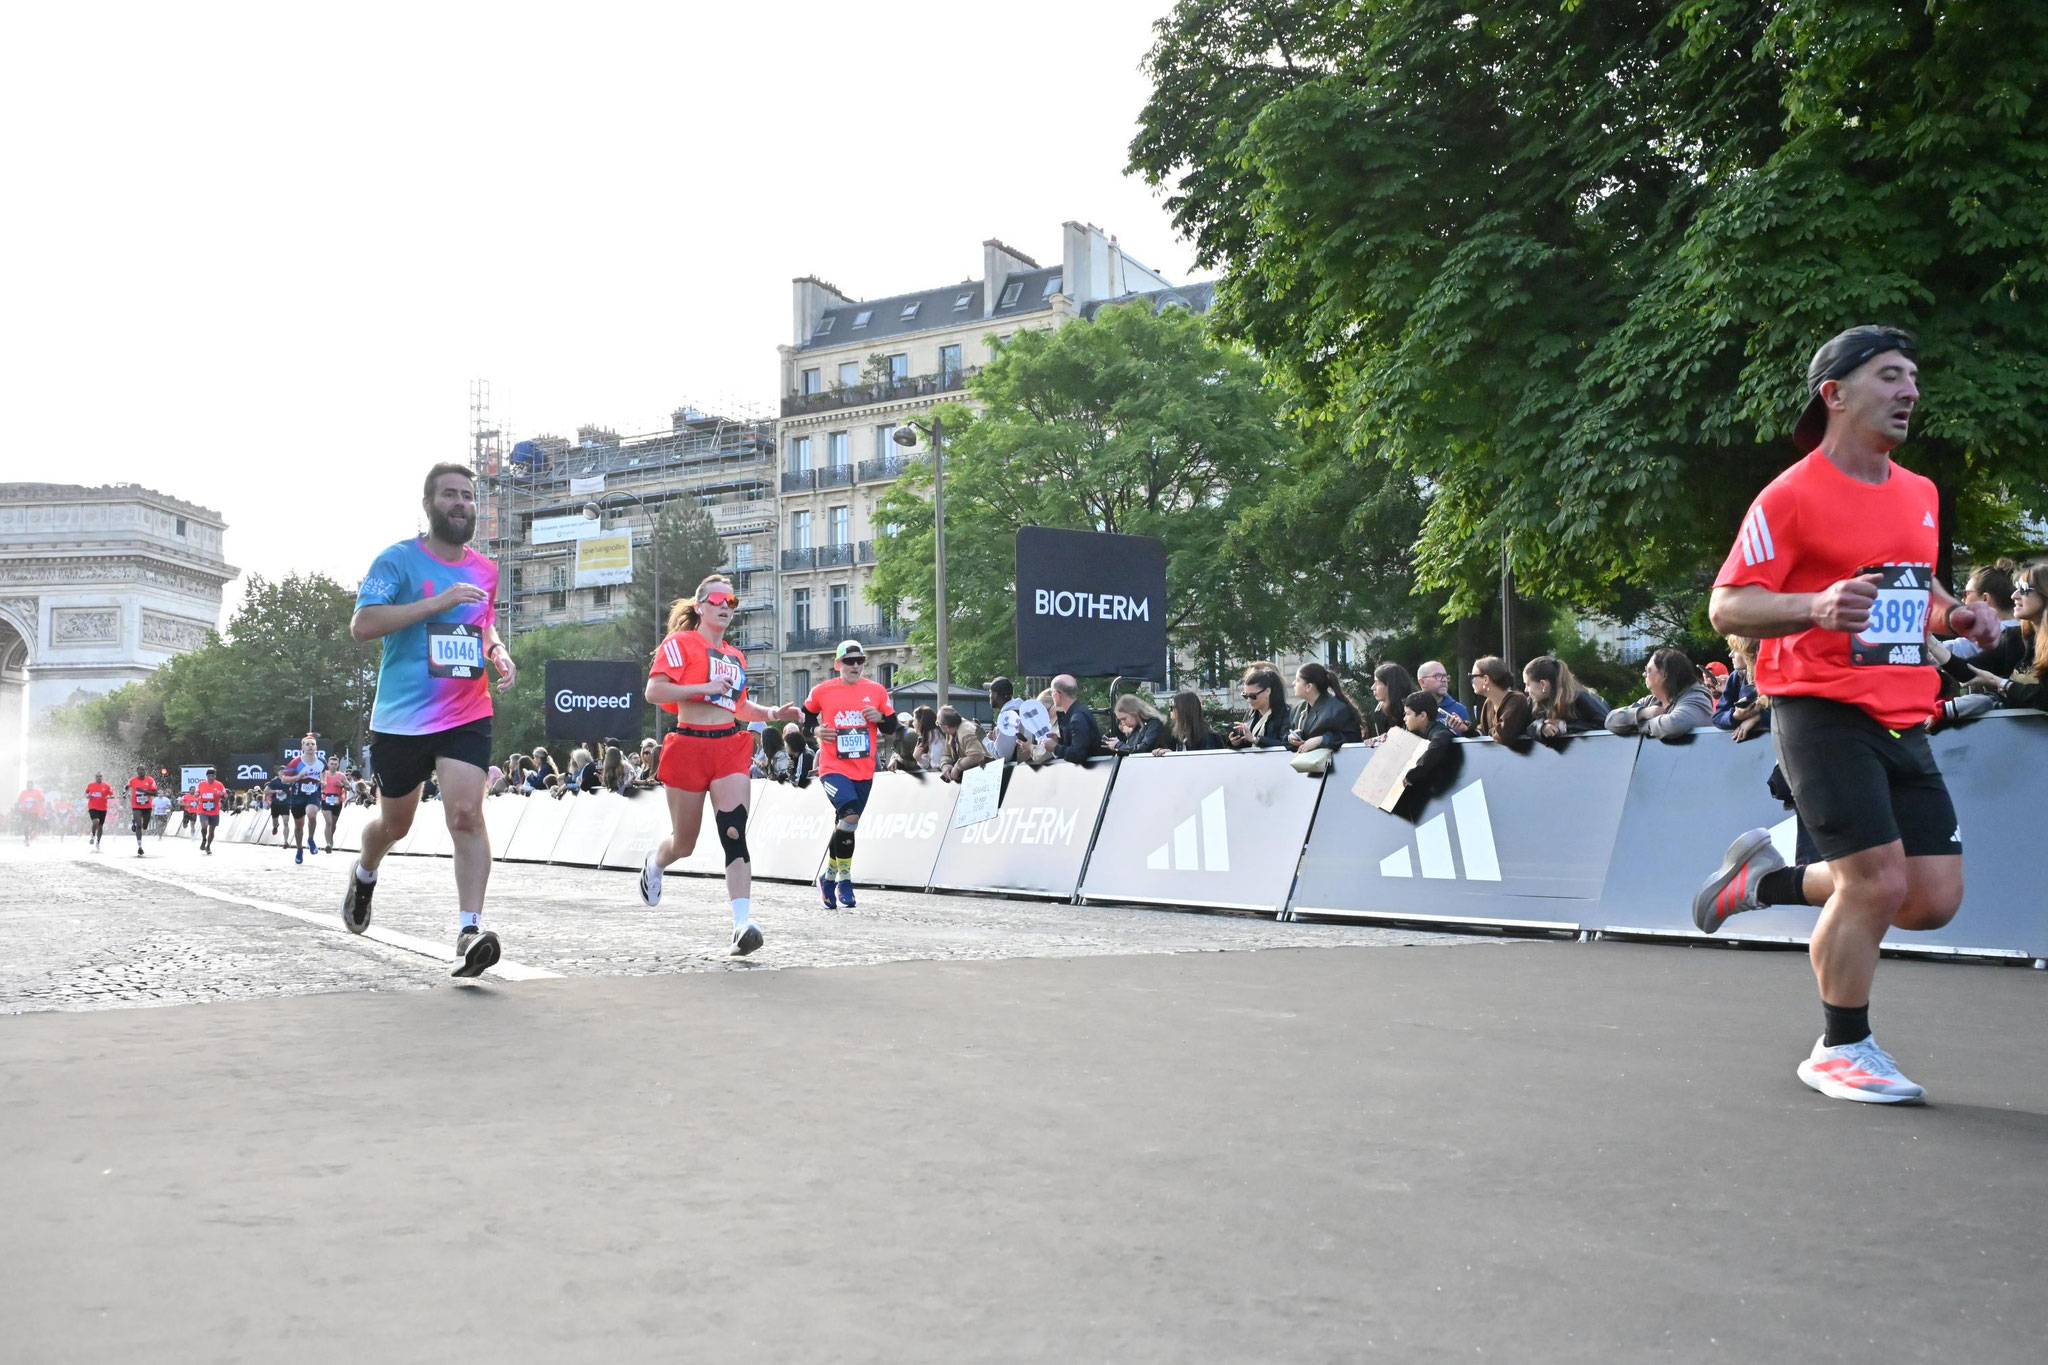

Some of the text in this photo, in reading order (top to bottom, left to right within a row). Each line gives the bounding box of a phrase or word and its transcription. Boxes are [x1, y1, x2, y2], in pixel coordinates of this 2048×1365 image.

[1035, 588, 1149, 621] BIOTHERM
[437, 640, 474, 661] 16146
[1888, 652, 1921, 664] PARIS
[555, 689, 632, 713] Compeed
[841, 735, 863, 747] 13591
[285, 749, 326, 759] POR
